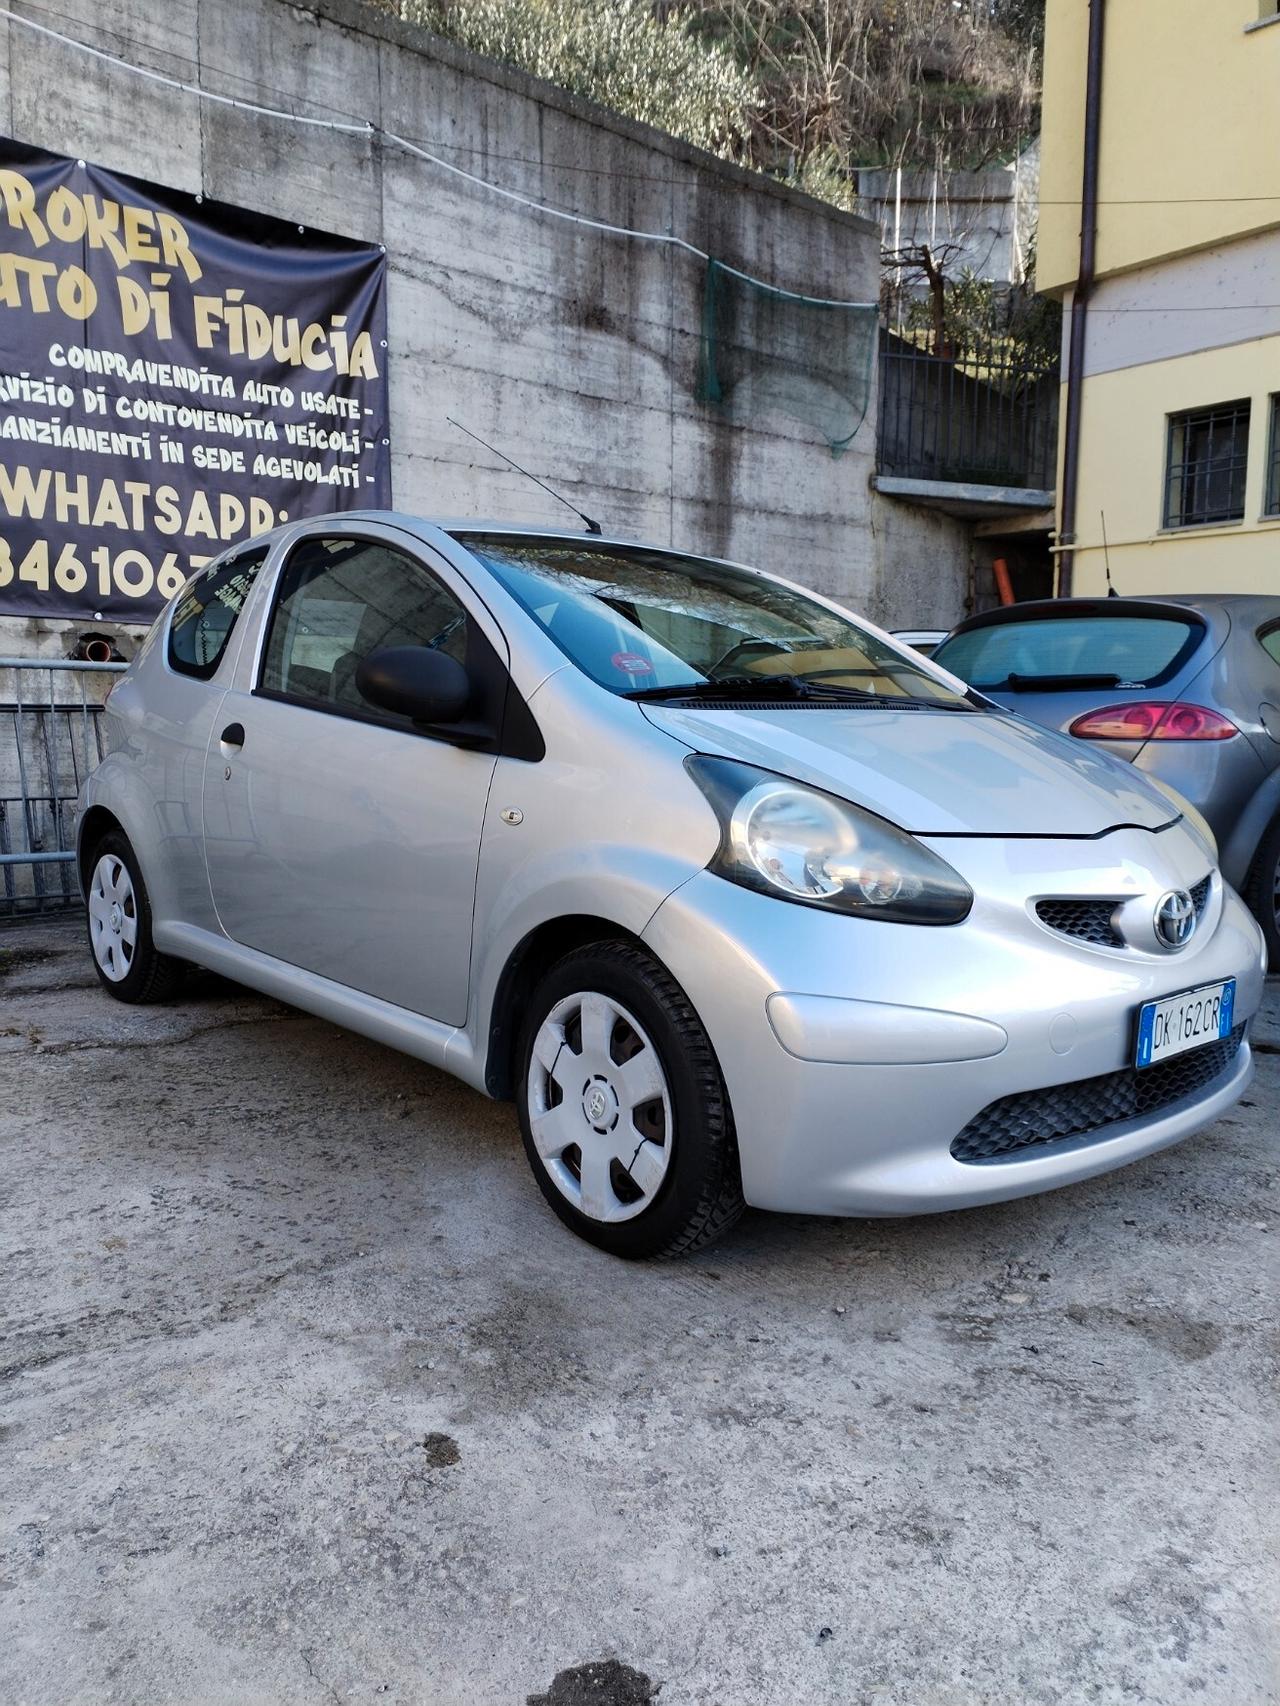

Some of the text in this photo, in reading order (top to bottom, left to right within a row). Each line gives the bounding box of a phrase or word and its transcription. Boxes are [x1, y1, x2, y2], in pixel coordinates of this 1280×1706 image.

[0, 170, 203, 284] ROKER
[116, 272, 173, 341] DI
[193, 288, 380, 381] FIDUCIA
[48, 343, 236, 399] COMPRAVENDITA
[242, 379, 295, 408] AUTO
[300, 391, 361, 420] USATE
[0, 414, 152, 460] ANZIAMENTI
[192, 445, 246, 473] SEDE
[252, 454, 360, 489] AGEVOLATI
[82, 386, 108, 415] DI
[115, 395, 279, 442] CONTOVENDITA
[284, 421, 361, 455] VEICOLI
[1154, 1009, 1174, 1050] DK
